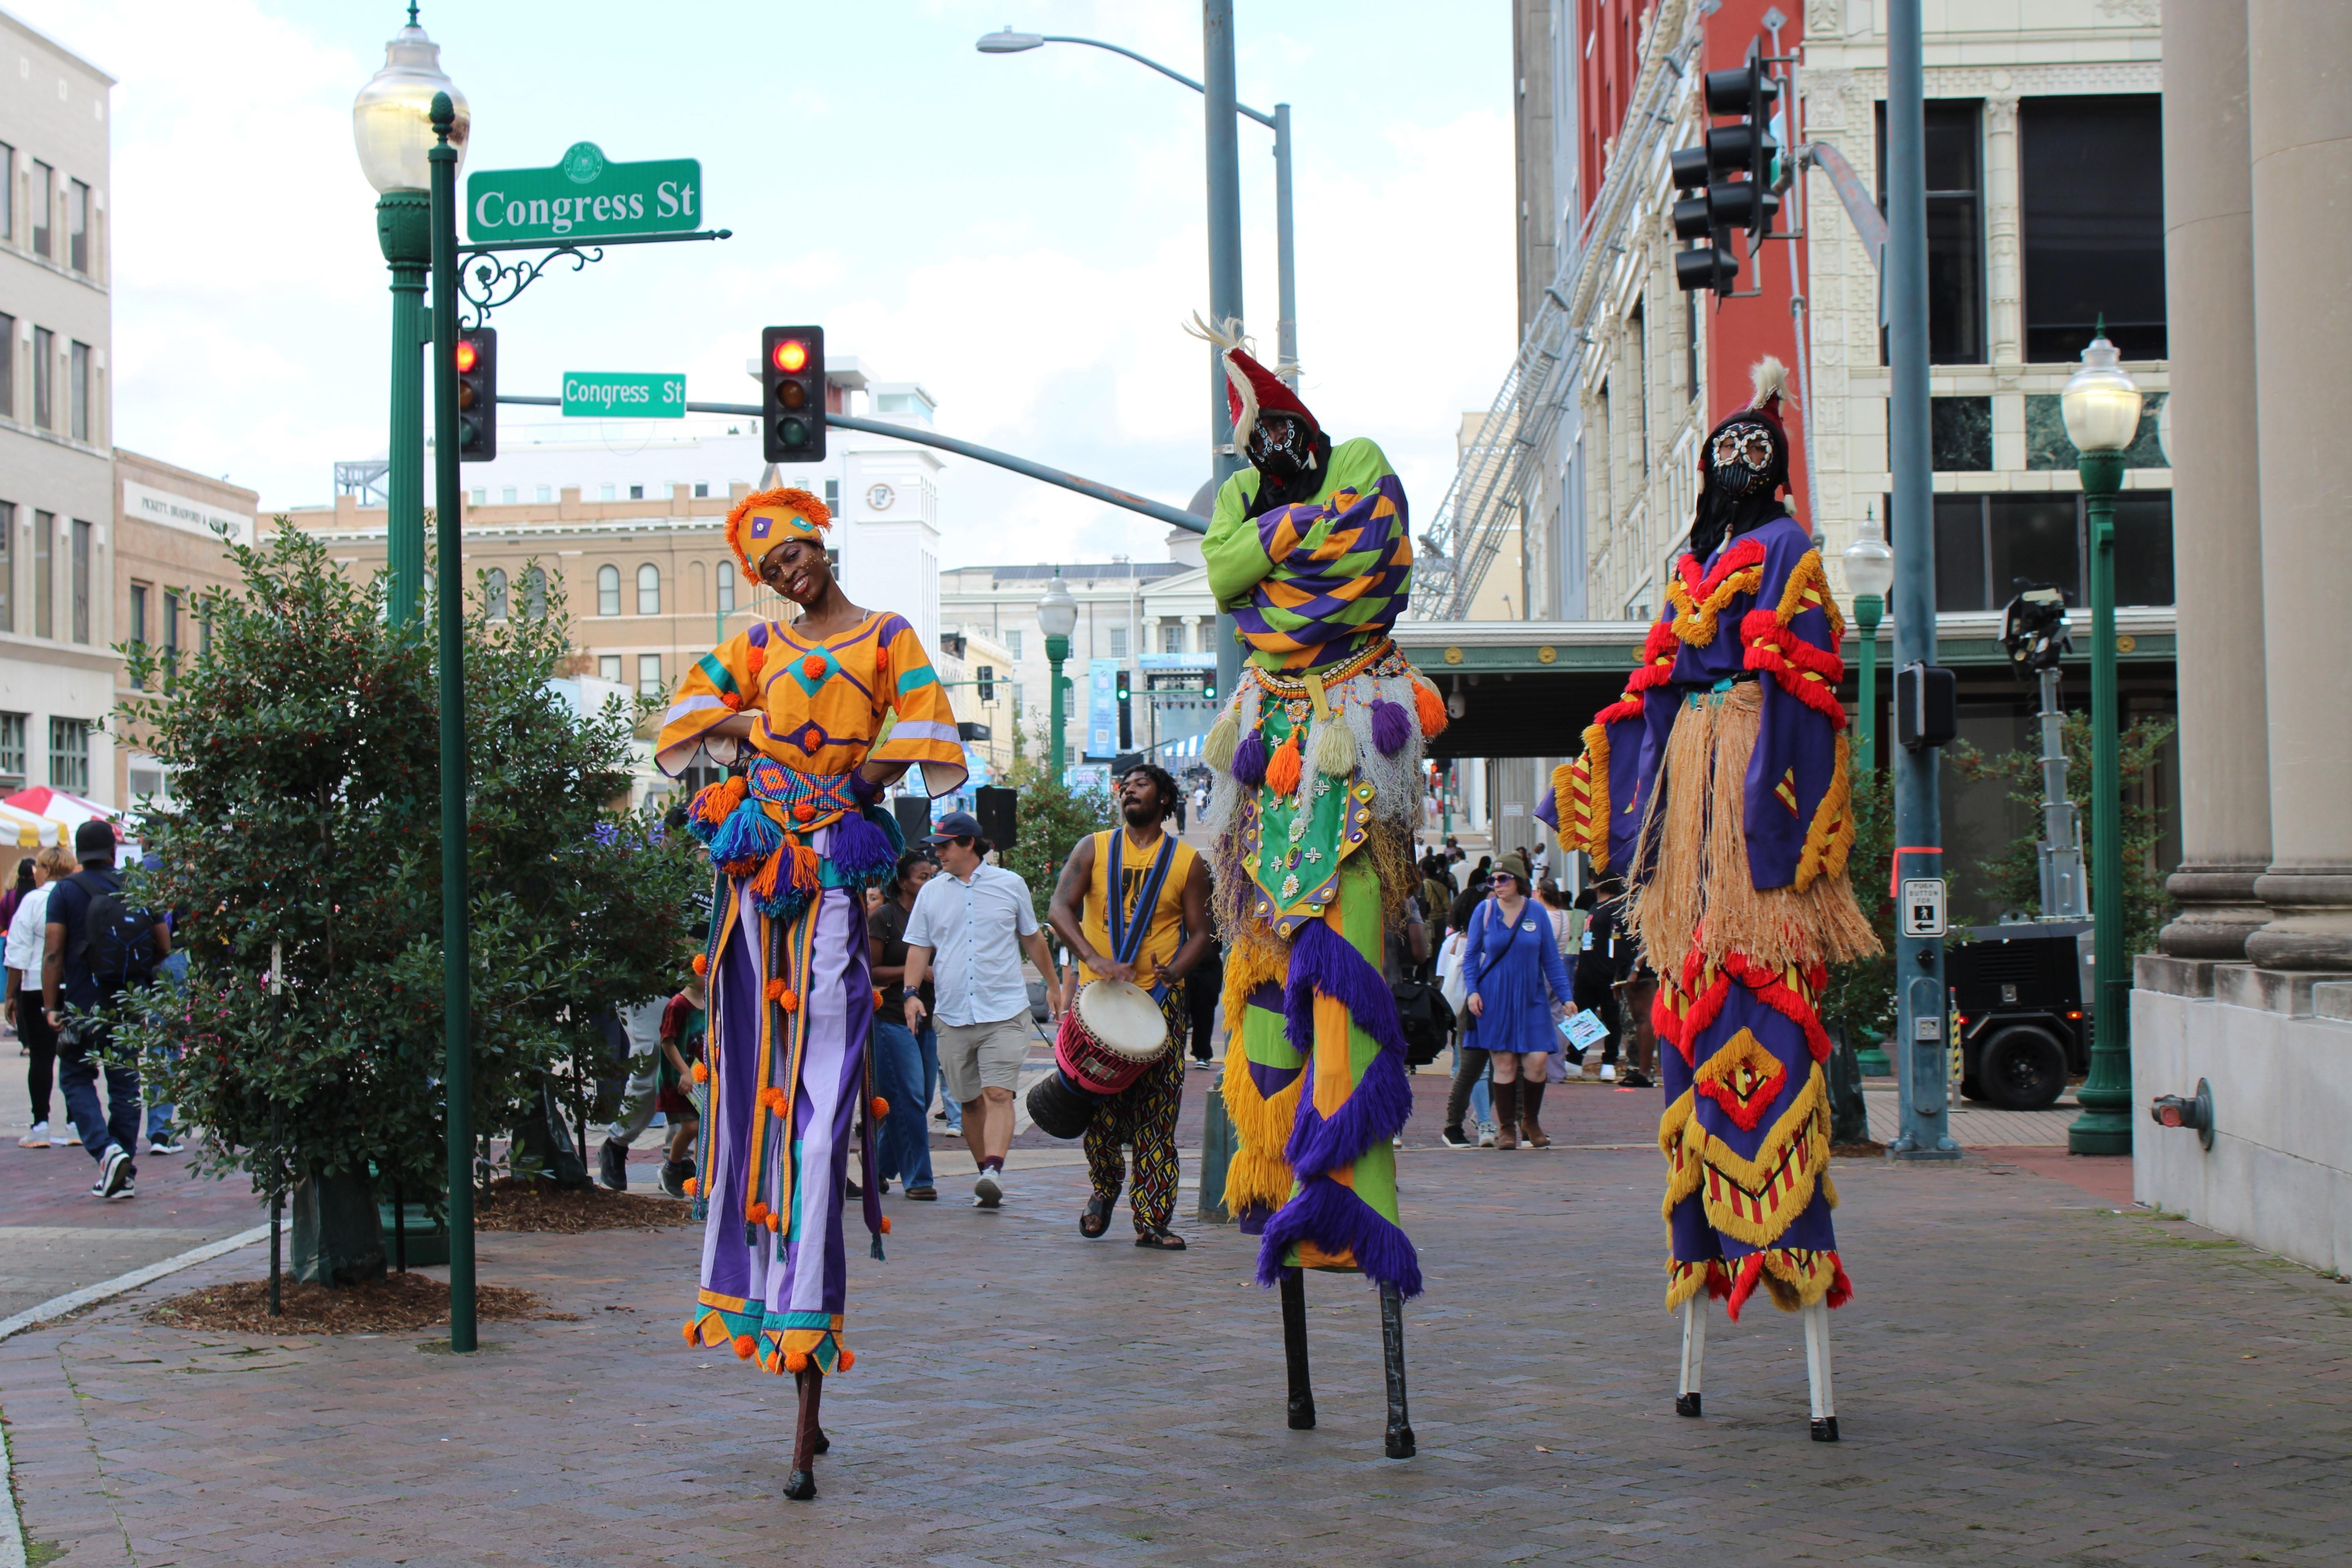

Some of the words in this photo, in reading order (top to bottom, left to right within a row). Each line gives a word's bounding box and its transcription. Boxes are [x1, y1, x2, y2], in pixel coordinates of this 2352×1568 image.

[475, 191, 644, 232] Congress
[657, 181, 695, 218] St
[566, 379, 650, 410] Congress
[662, 381, 682, 403] St
[875, 488, 887, 505] F
